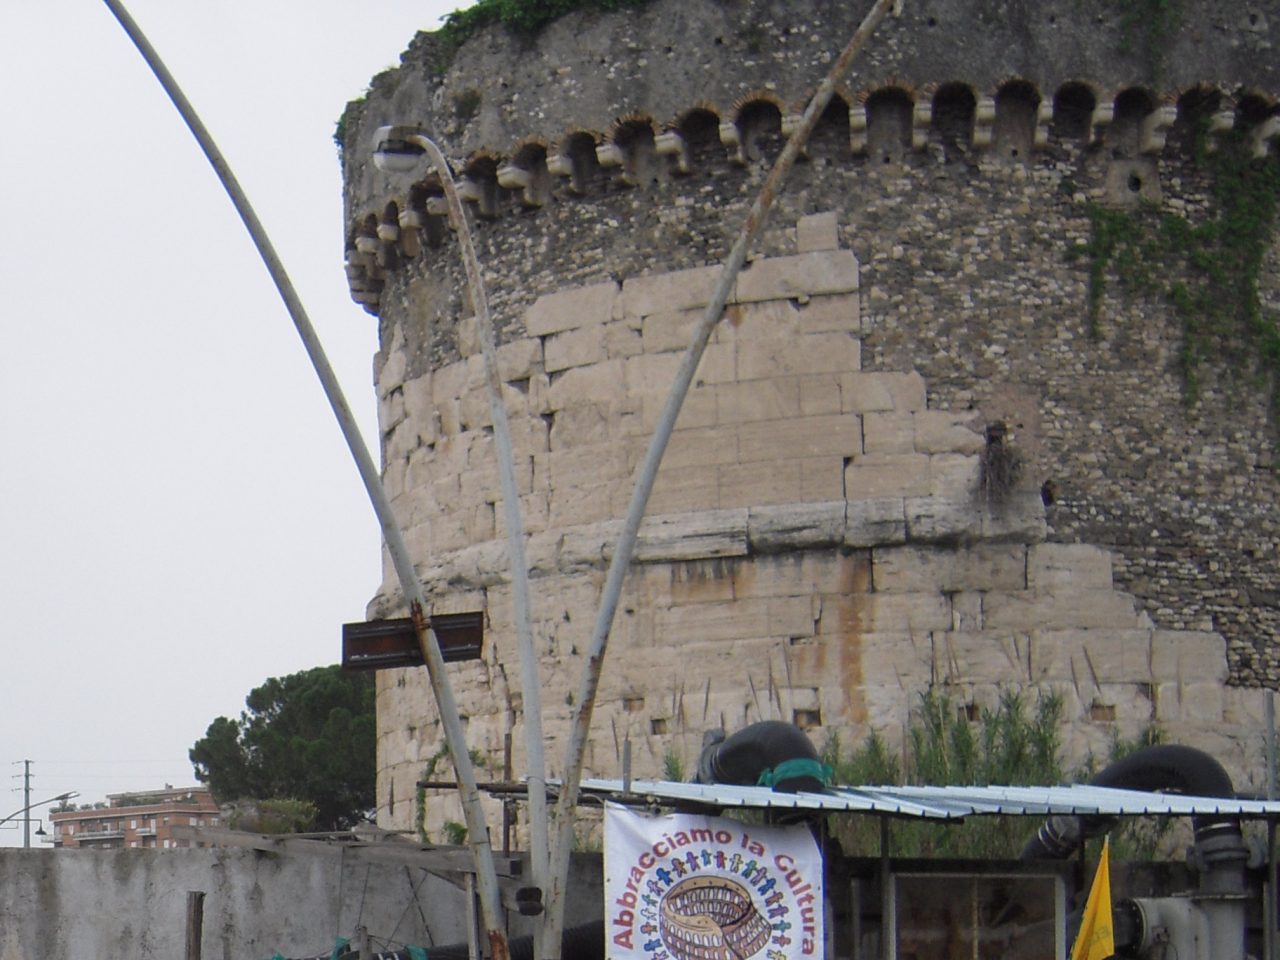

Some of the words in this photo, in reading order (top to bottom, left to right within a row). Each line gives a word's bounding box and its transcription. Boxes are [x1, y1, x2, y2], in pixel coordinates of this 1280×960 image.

[613, 828, 732, 950] Abbracciamo
[741, 832, 765, 858] la
[773, 853, 816, 956] Cultura
